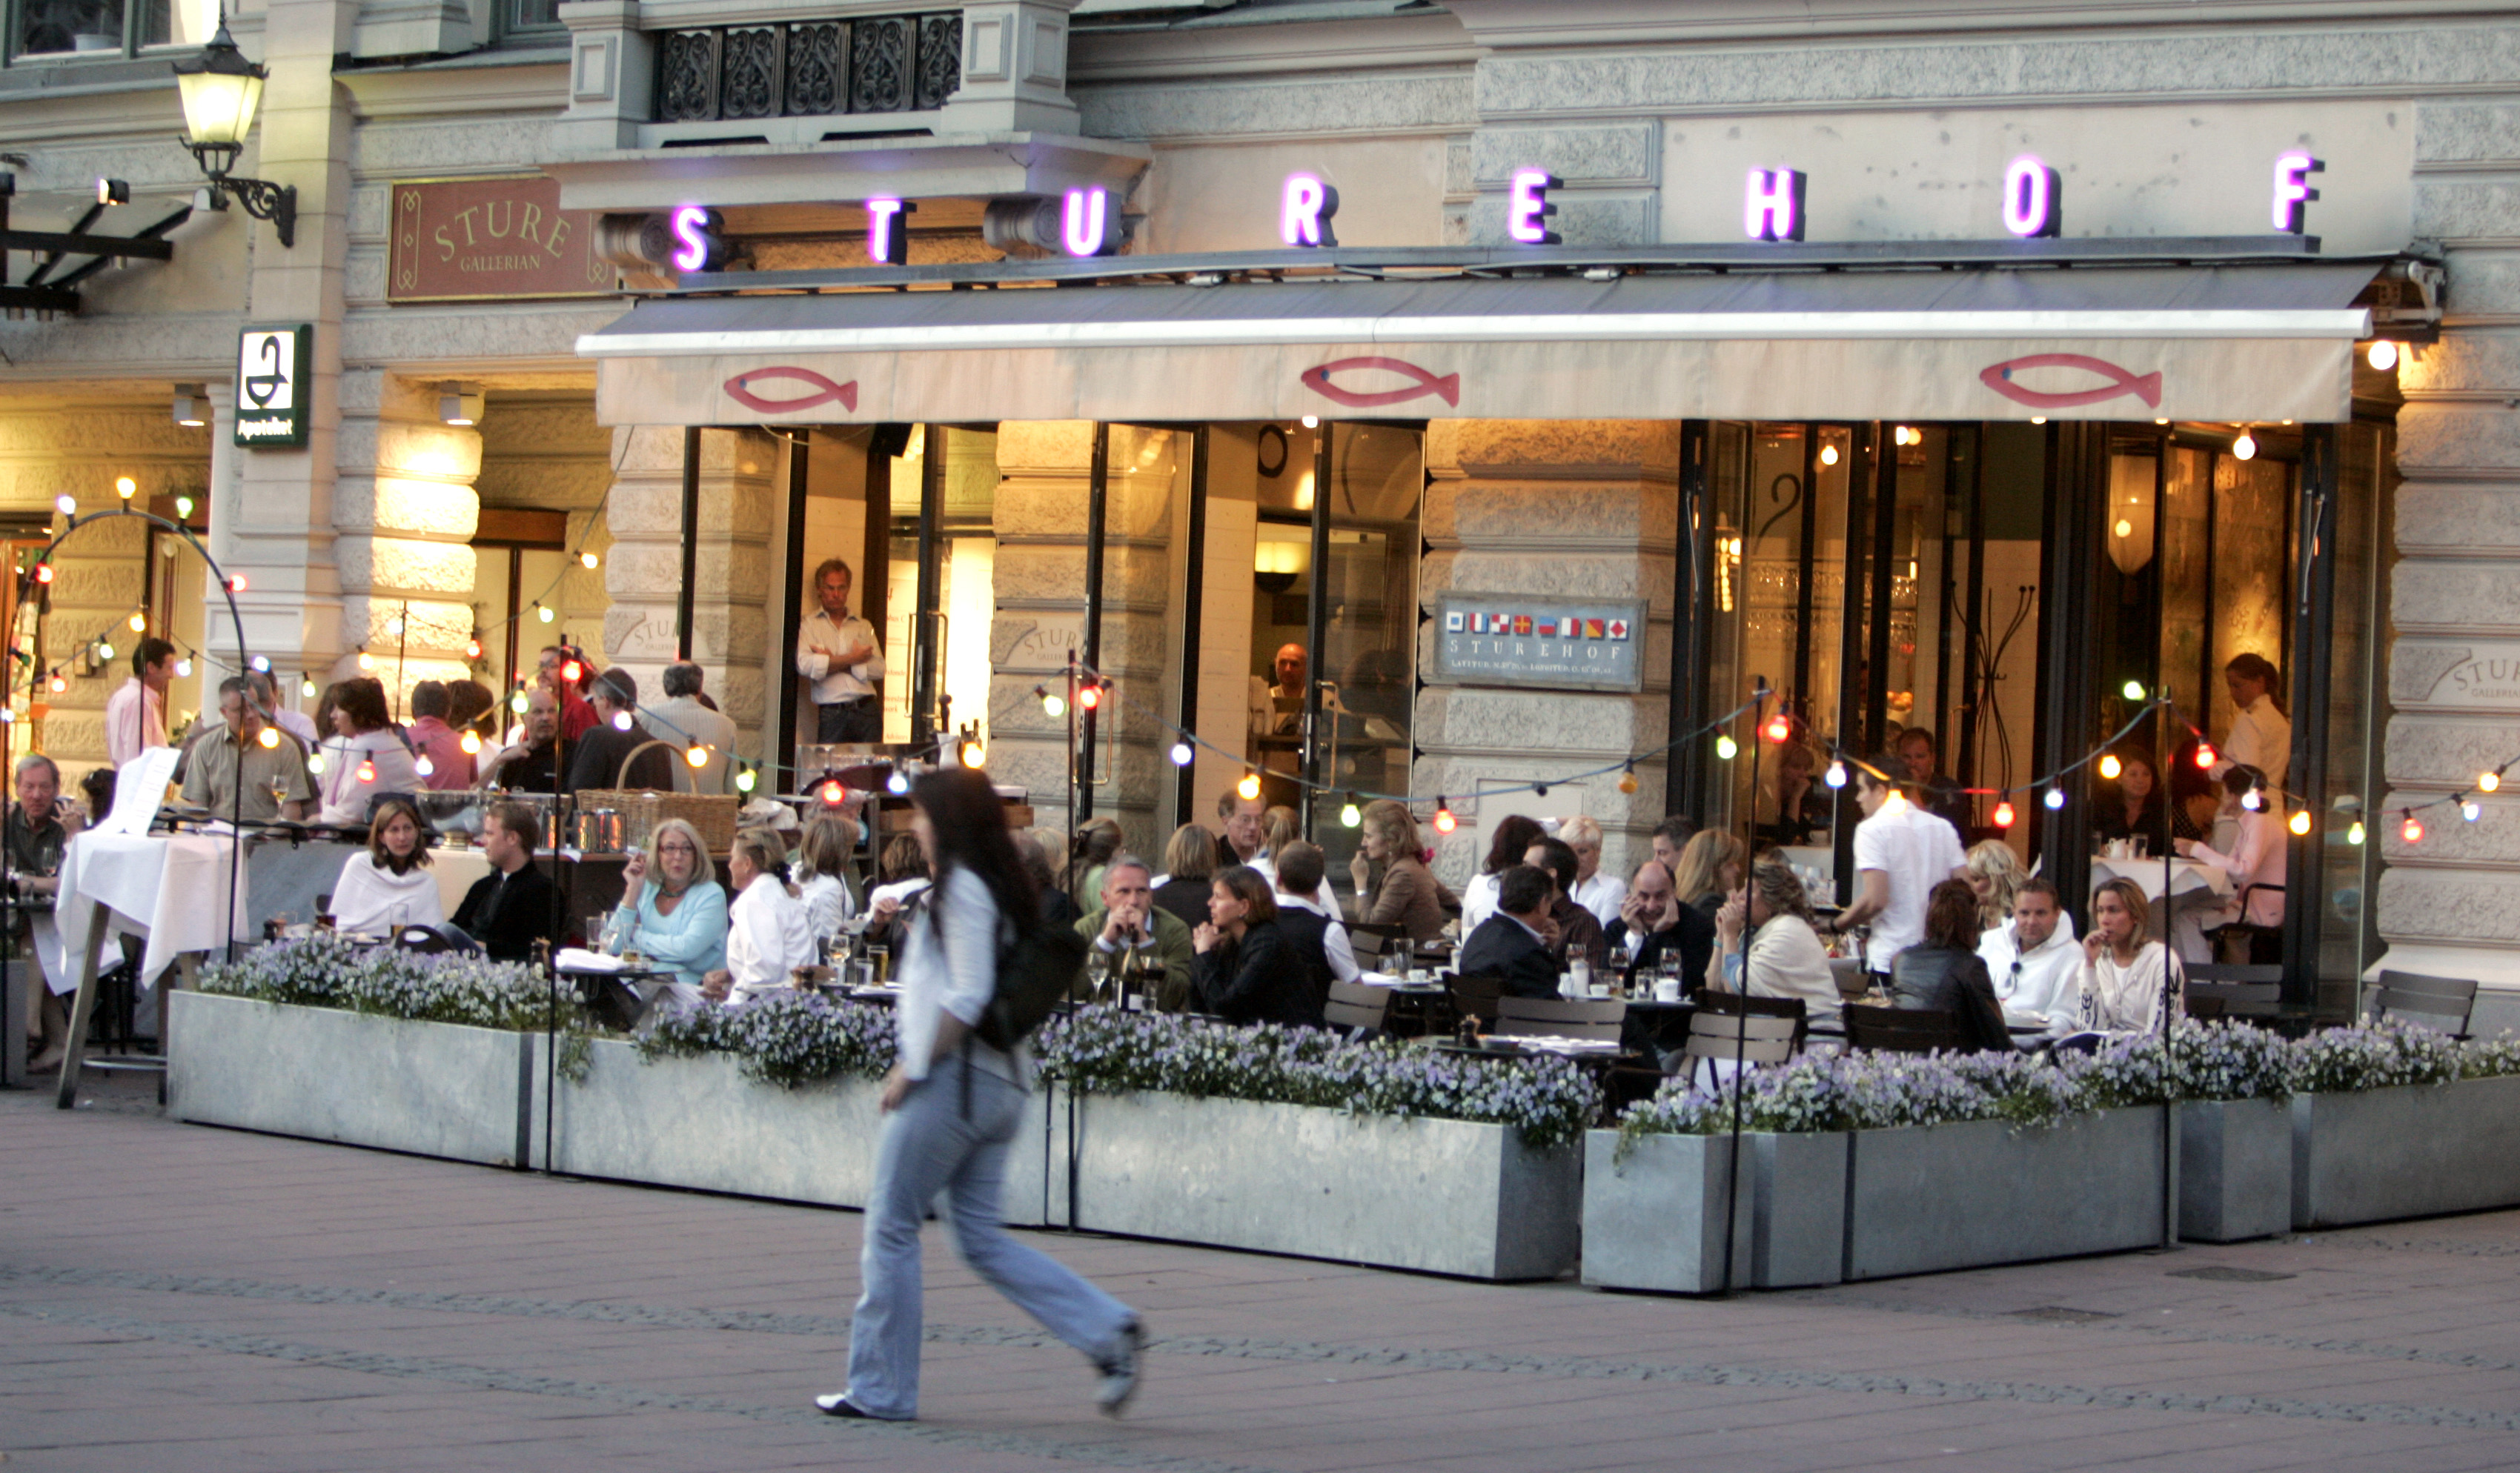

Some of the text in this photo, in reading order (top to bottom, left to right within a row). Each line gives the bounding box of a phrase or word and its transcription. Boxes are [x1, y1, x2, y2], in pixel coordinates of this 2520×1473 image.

[671, 153, 2317, 272] STUREHOF
[435, 200, 571, 262] STURE
[460, 254, 540, 272] GALLERIAN
[237, 416, 293, 440] Apoteket
[1450, 639, 1620, 660] STUREHOF
